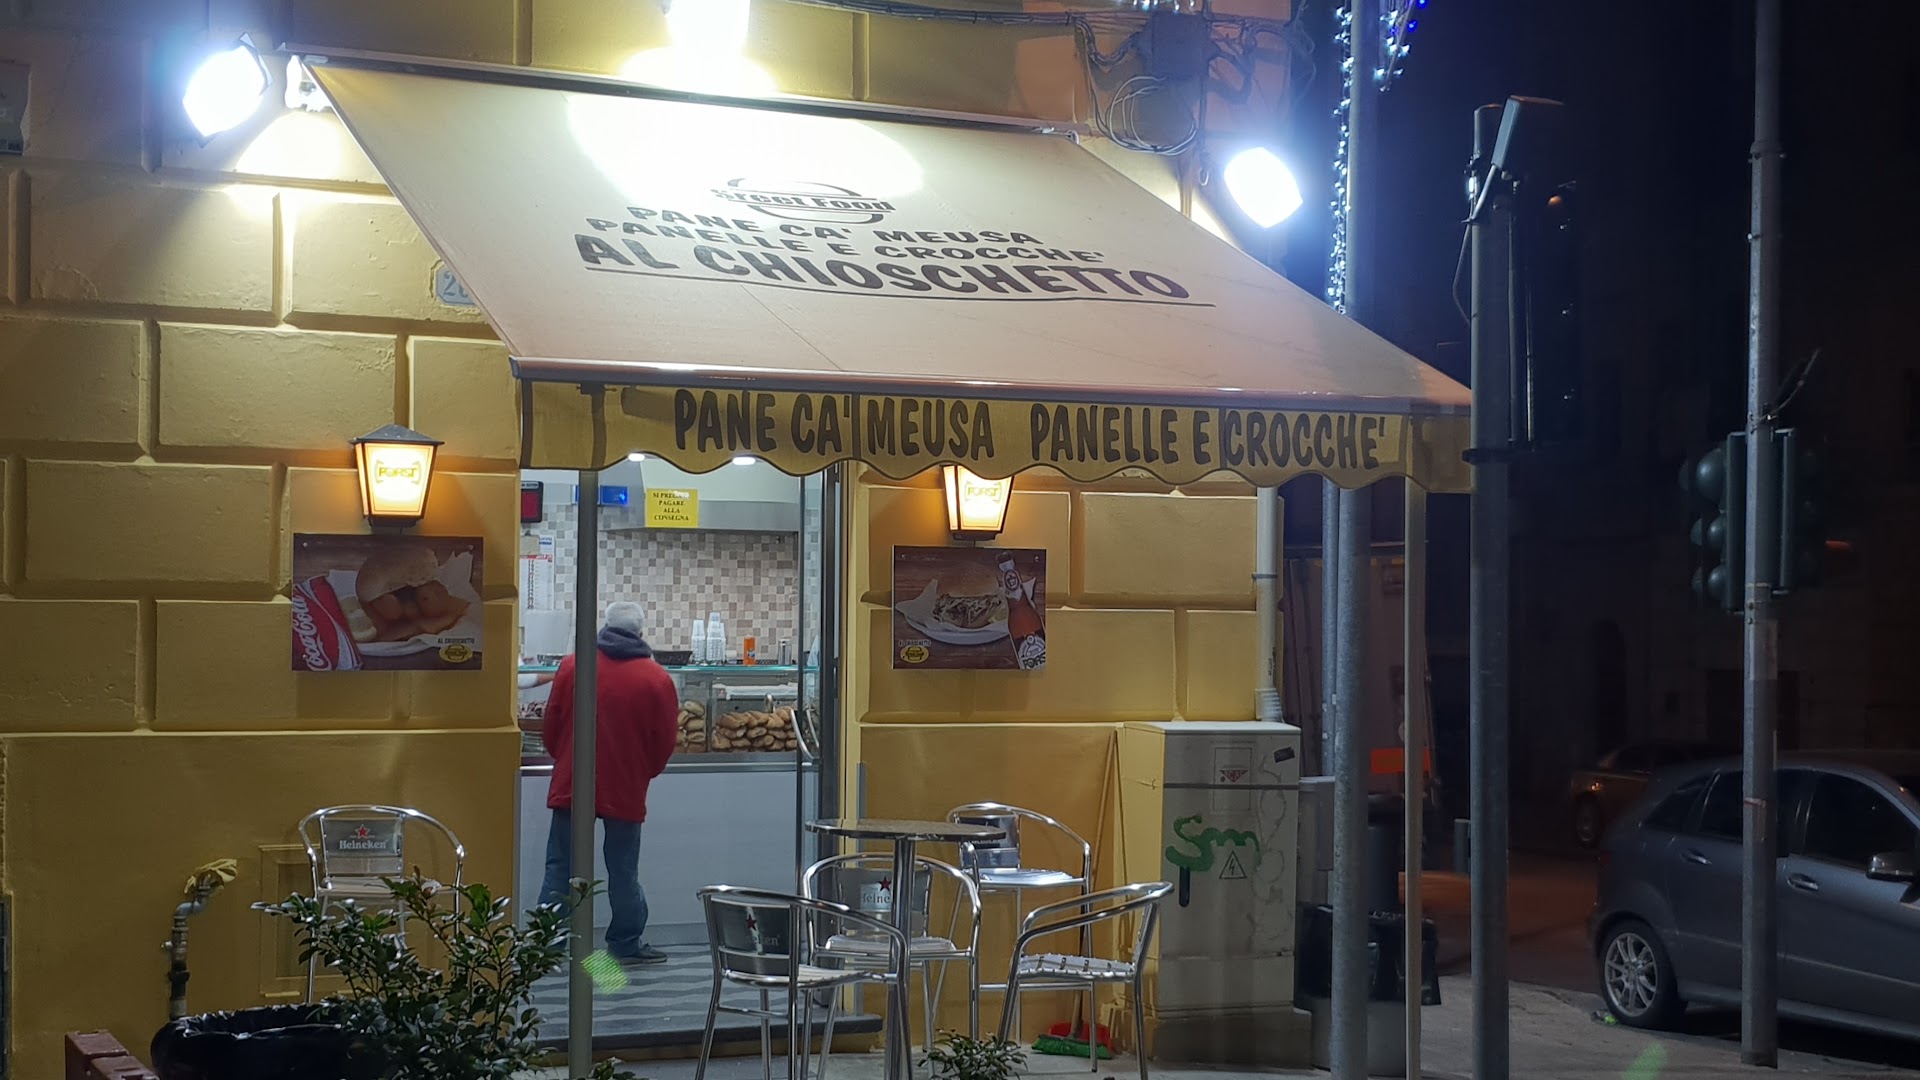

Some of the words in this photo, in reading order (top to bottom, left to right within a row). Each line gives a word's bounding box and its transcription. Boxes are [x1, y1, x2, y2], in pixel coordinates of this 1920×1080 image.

[626, 206, 764, 233] PANE
[779, 224, 852, 240] CA'
[872, 230, 1043, 245] MEUSA
[811, 198, 896, 211] Food
[586, 218, 814, 253] PANELLE
[827, 243, 861, 256] E
[874, 246, 1104, 263] CROCCHE'
[574, 233, 680, 270] AL
[693, 244, 1190, 299] CHIOSCHETTO
[674, 389, 777, 453] PANE
[790, 393, 850, 456] CA'
[867, 397, 995, 460] MEUSA
[1030, 403, 1179, 464] PANELLE
[1193, 410, 1211, 465] E
[1223, 409, 1385, 470] CROCCHE'
[339, 839, 388, 850] Heineken
